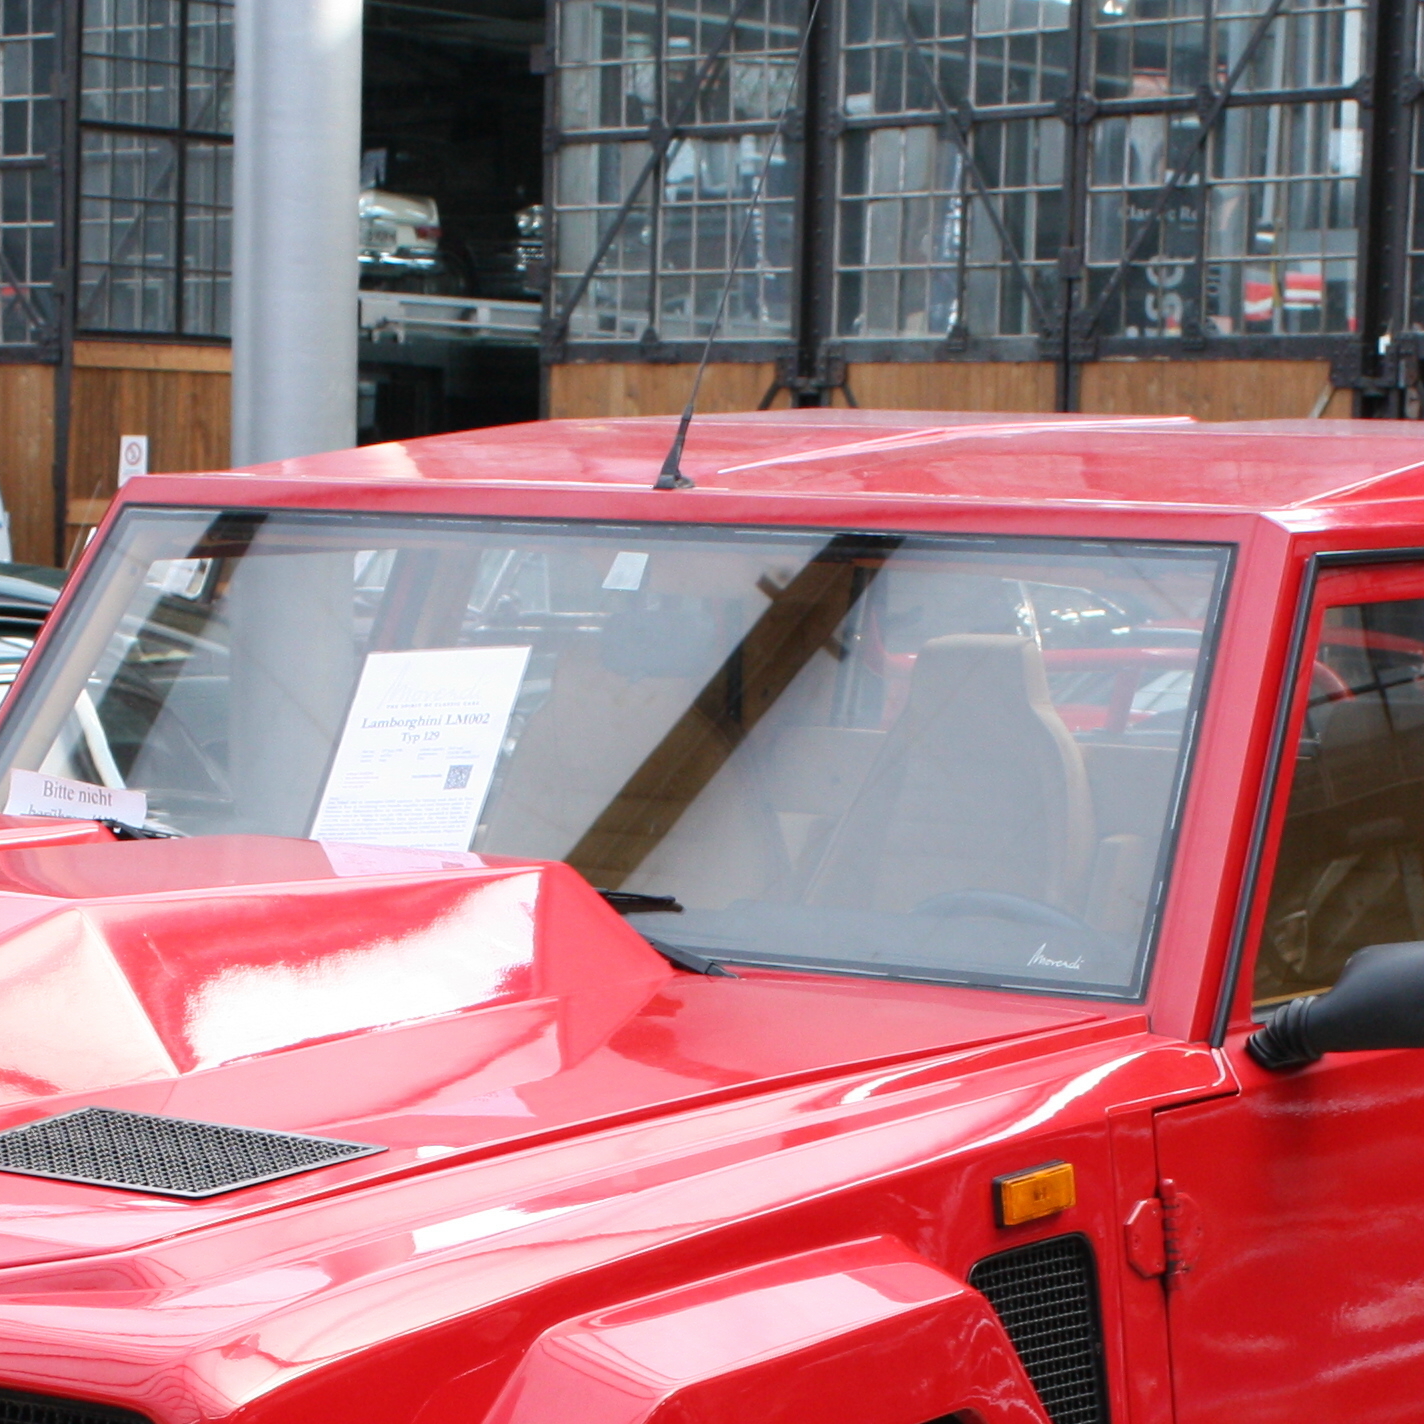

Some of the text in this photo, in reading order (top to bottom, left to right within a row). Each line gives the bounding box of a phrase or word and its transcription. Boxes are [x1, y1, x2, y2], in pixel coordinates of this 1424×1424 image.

[361, 712, 491, 730] Lamborghini LM002
[401, 730, 441, 744] Typ 129
[43, 780, 113, 807] Bitte nicht
